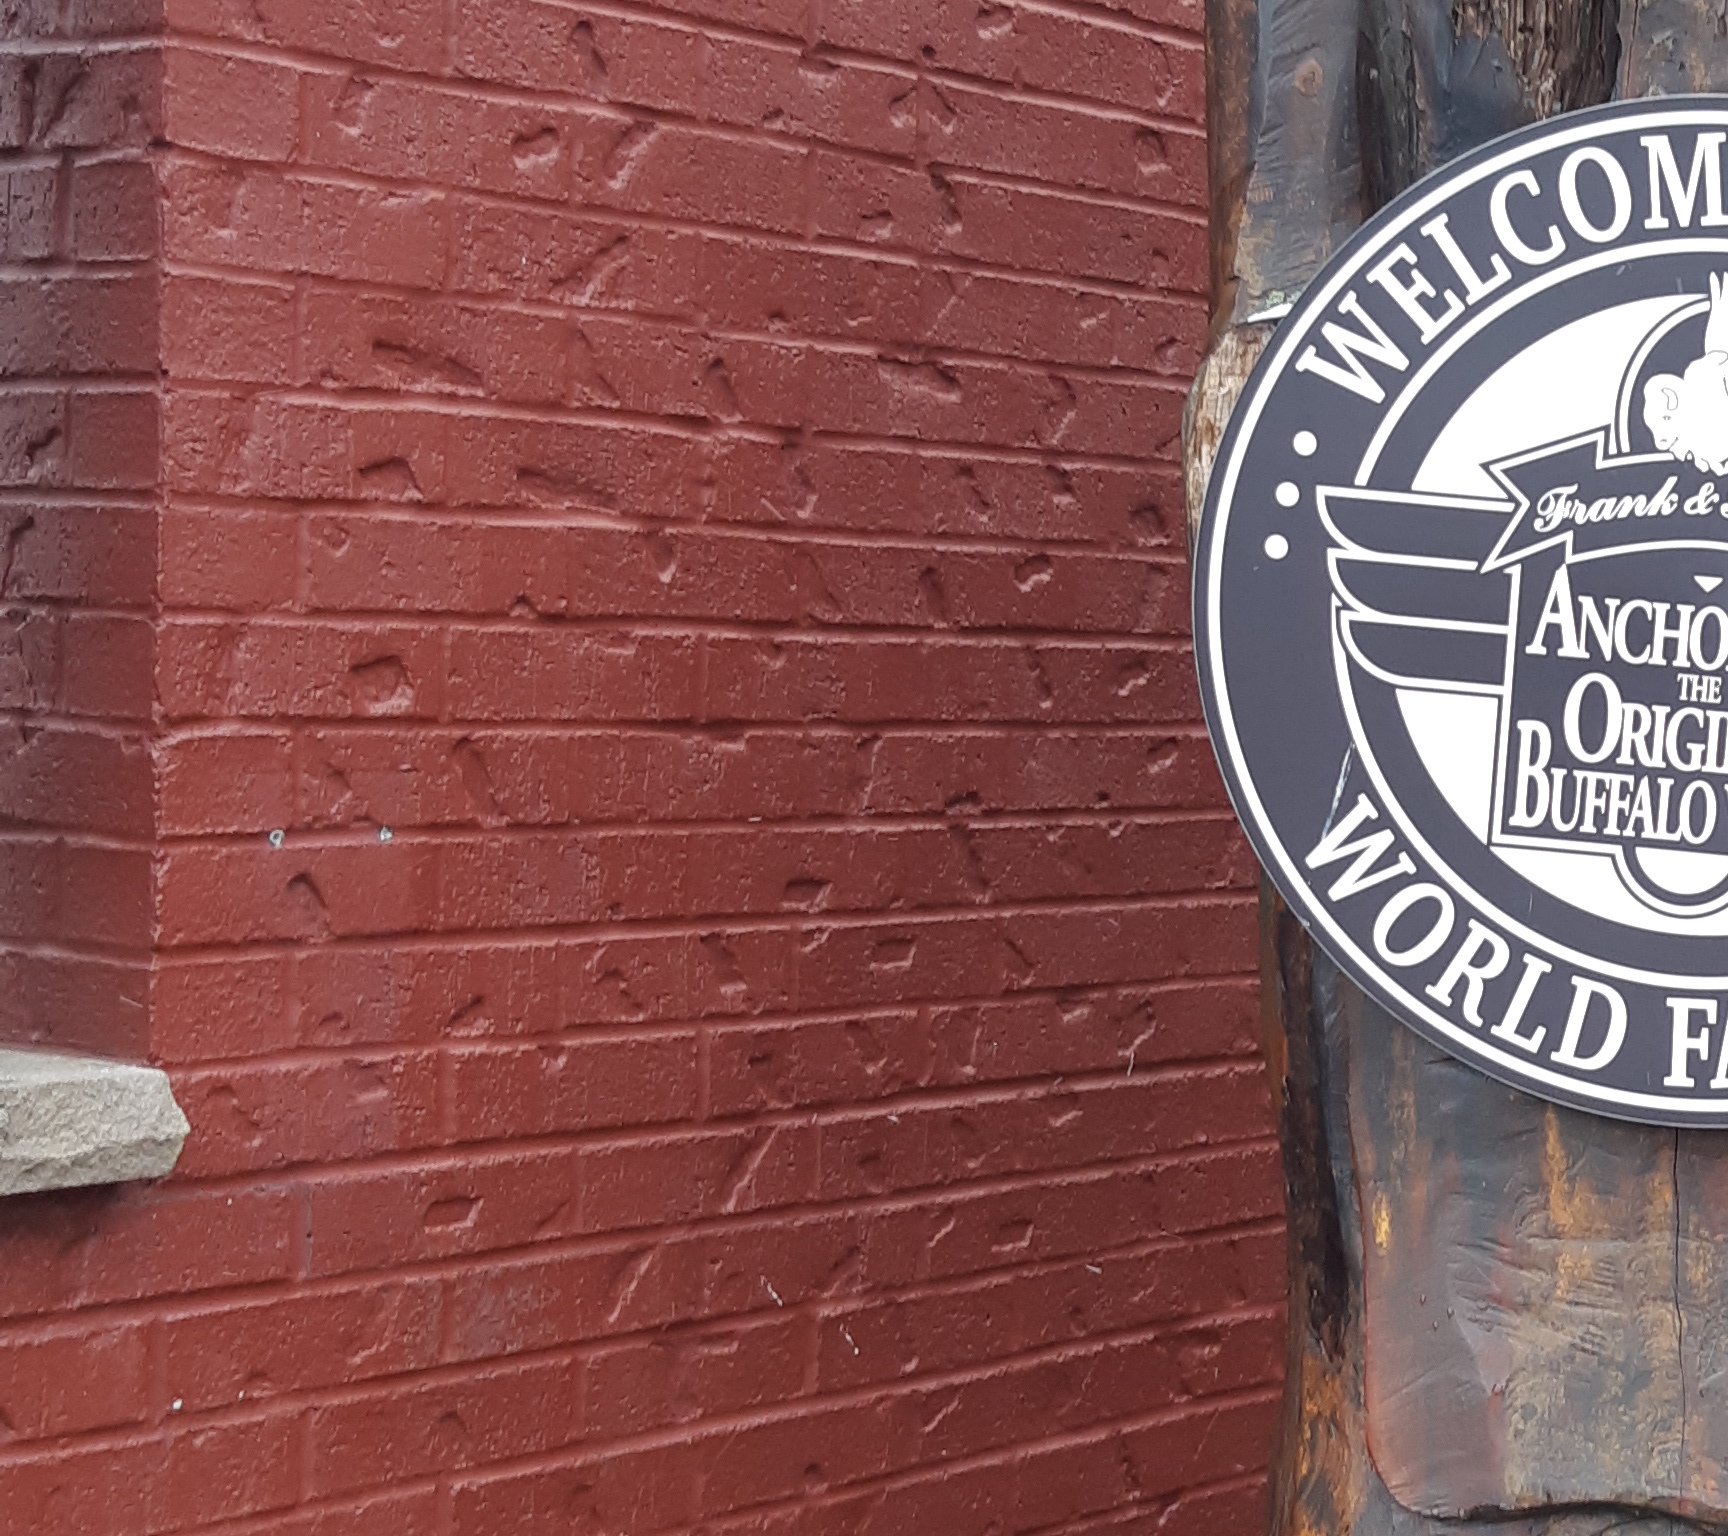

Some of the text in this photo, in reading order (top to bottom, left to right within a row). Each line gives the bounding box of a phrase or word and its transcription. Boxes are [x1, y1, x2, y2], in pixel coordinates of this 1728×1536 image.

[1534, 476, 1679, 533] Frank
[1683, 482, 1719, 517] &
[1677, 673, 1722, 704] THE
[1509, 719, 1717, 844] BUFFALO
[1305, 793, 1632, 1072] WORLD
